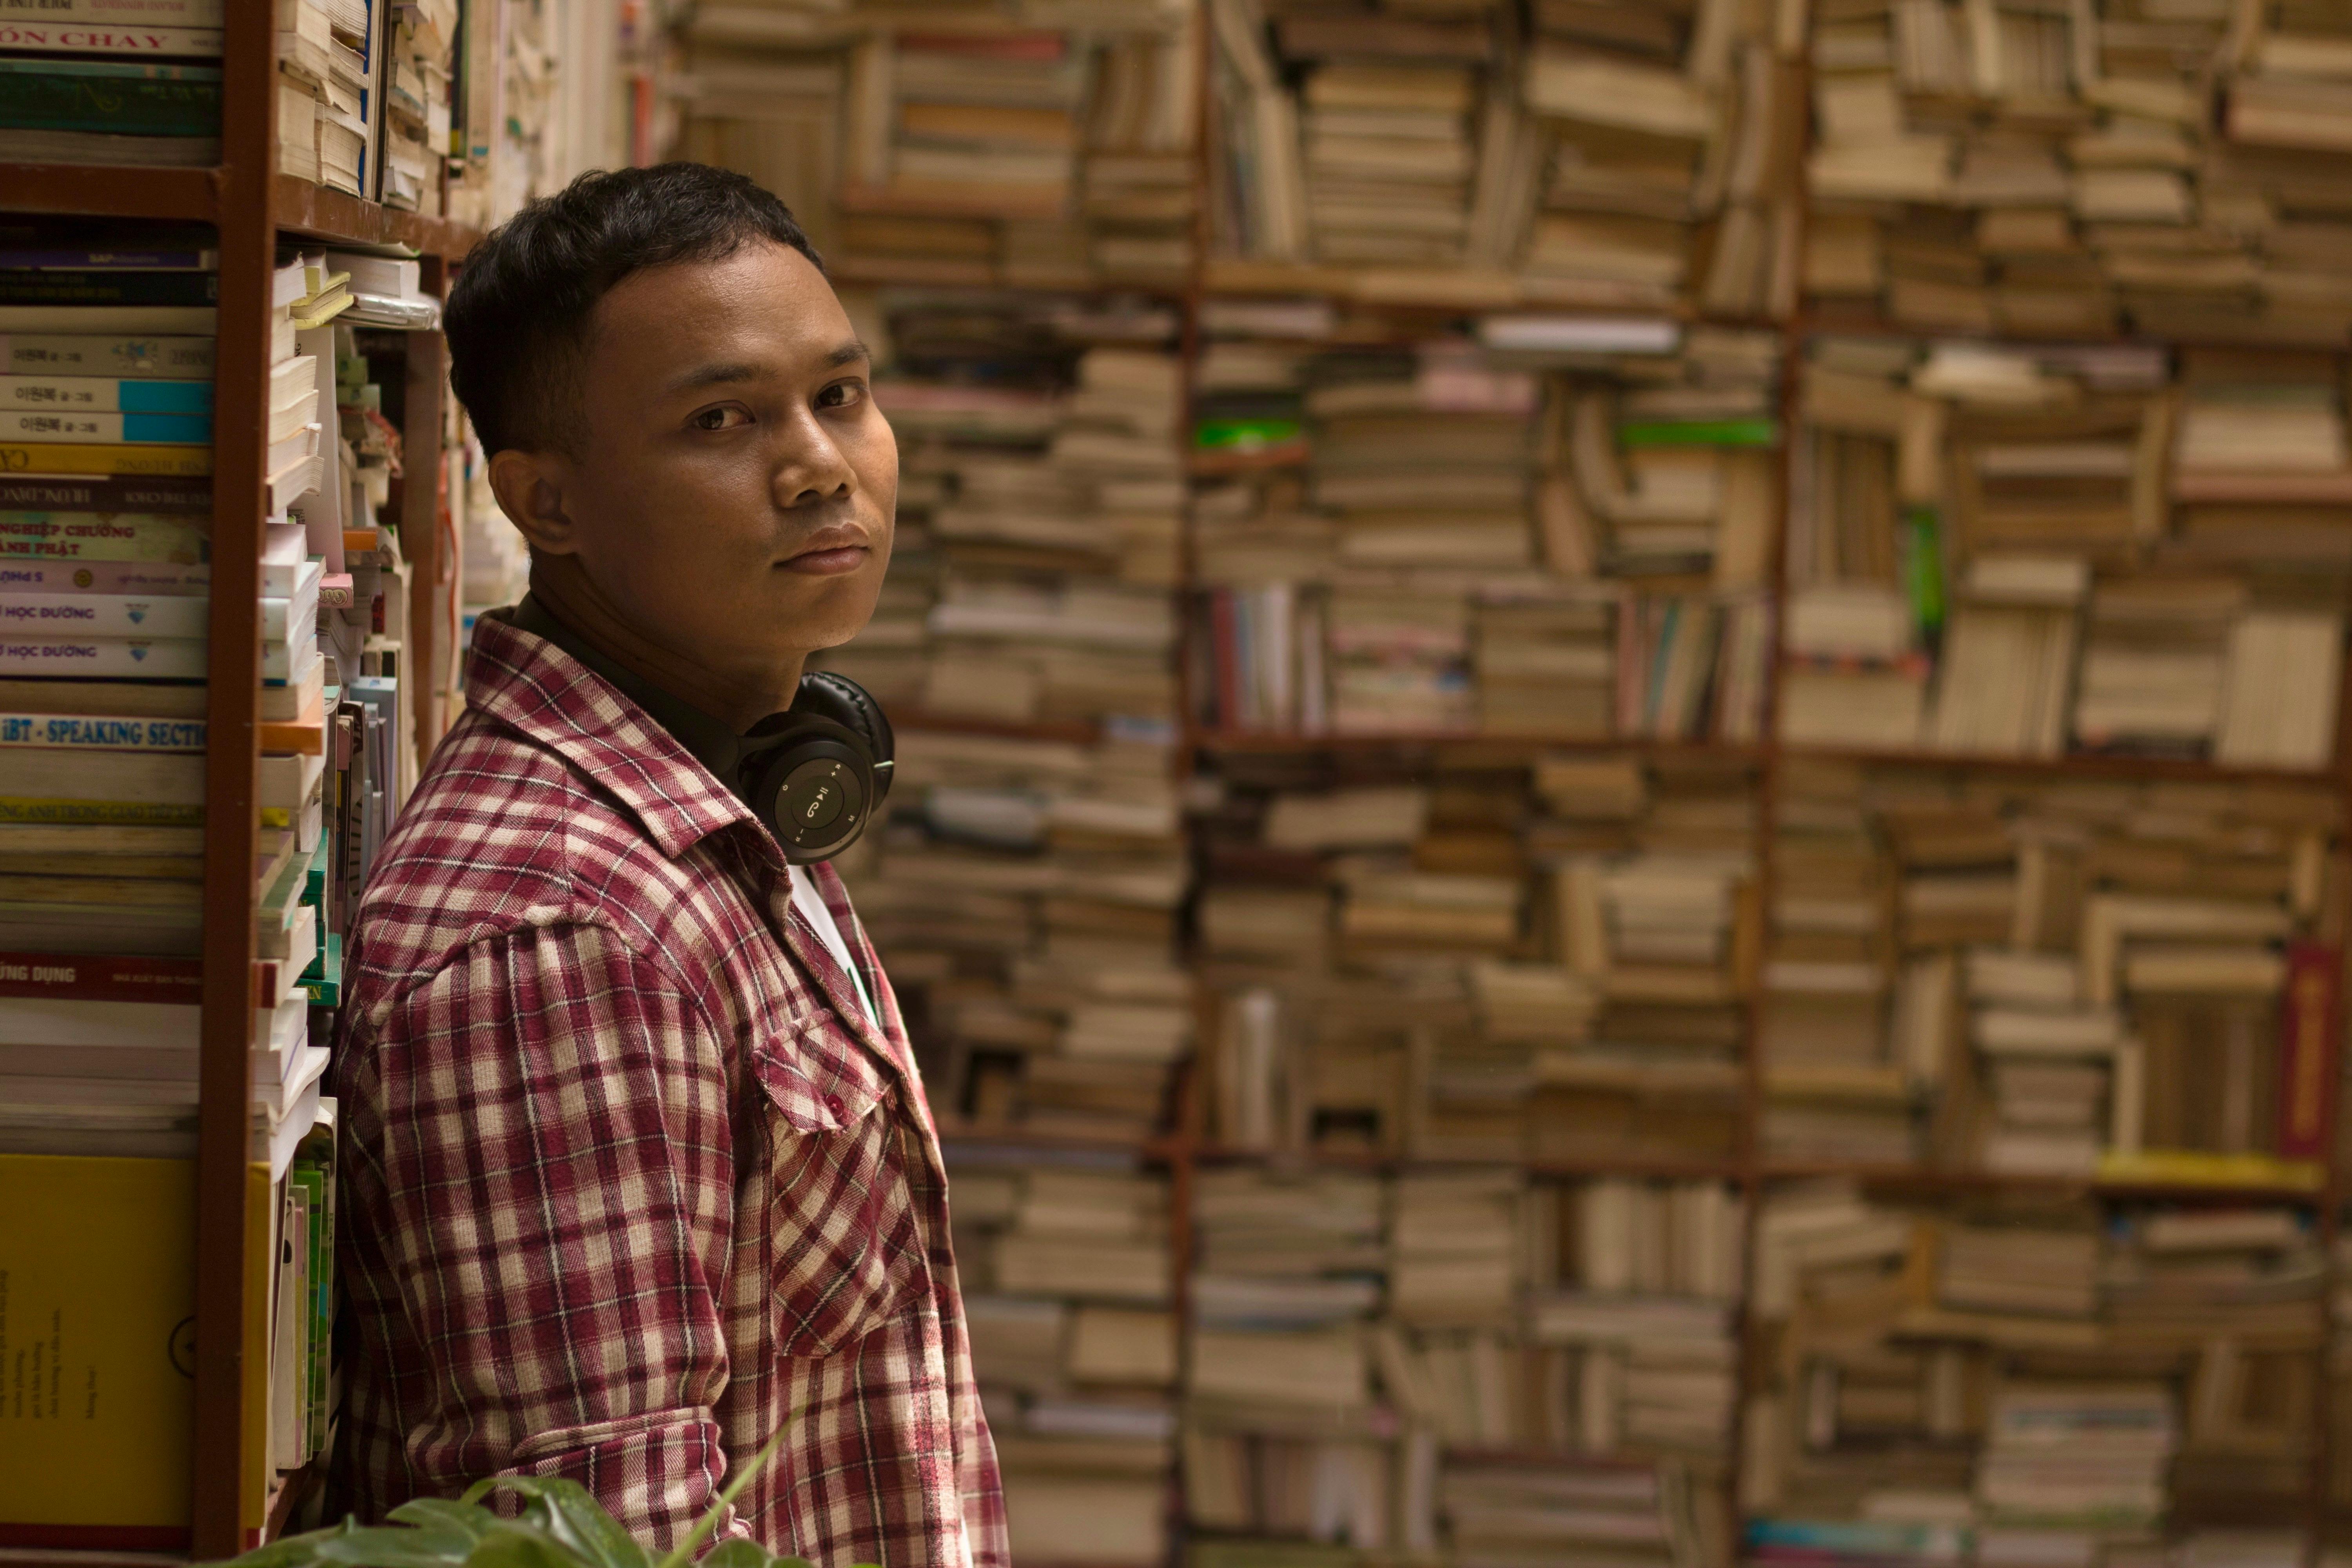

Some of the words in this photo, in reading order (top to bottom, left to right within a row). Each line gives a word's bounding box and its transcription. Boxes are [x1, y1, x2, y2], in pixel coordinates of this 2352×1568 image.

[60, 32, 167, 48] CHAY
[0, 522, 60, 537] NGHIỆP
[0, 571, 31, 584] PHÚ
[5, 607, 36, 621] HỌC
[40, 604, 94, 619] ĐƯỜNG
[7, 646, 38, 659] HỌC
[43, 643, 96, 657] ĐƯỜNG
[2, 719, 33, 741] iBT
[47, 720, 143, 745] SPEAKING
[148, 723, 207, 746] SECTI
[32, 965, 76, 985] DỤNG
